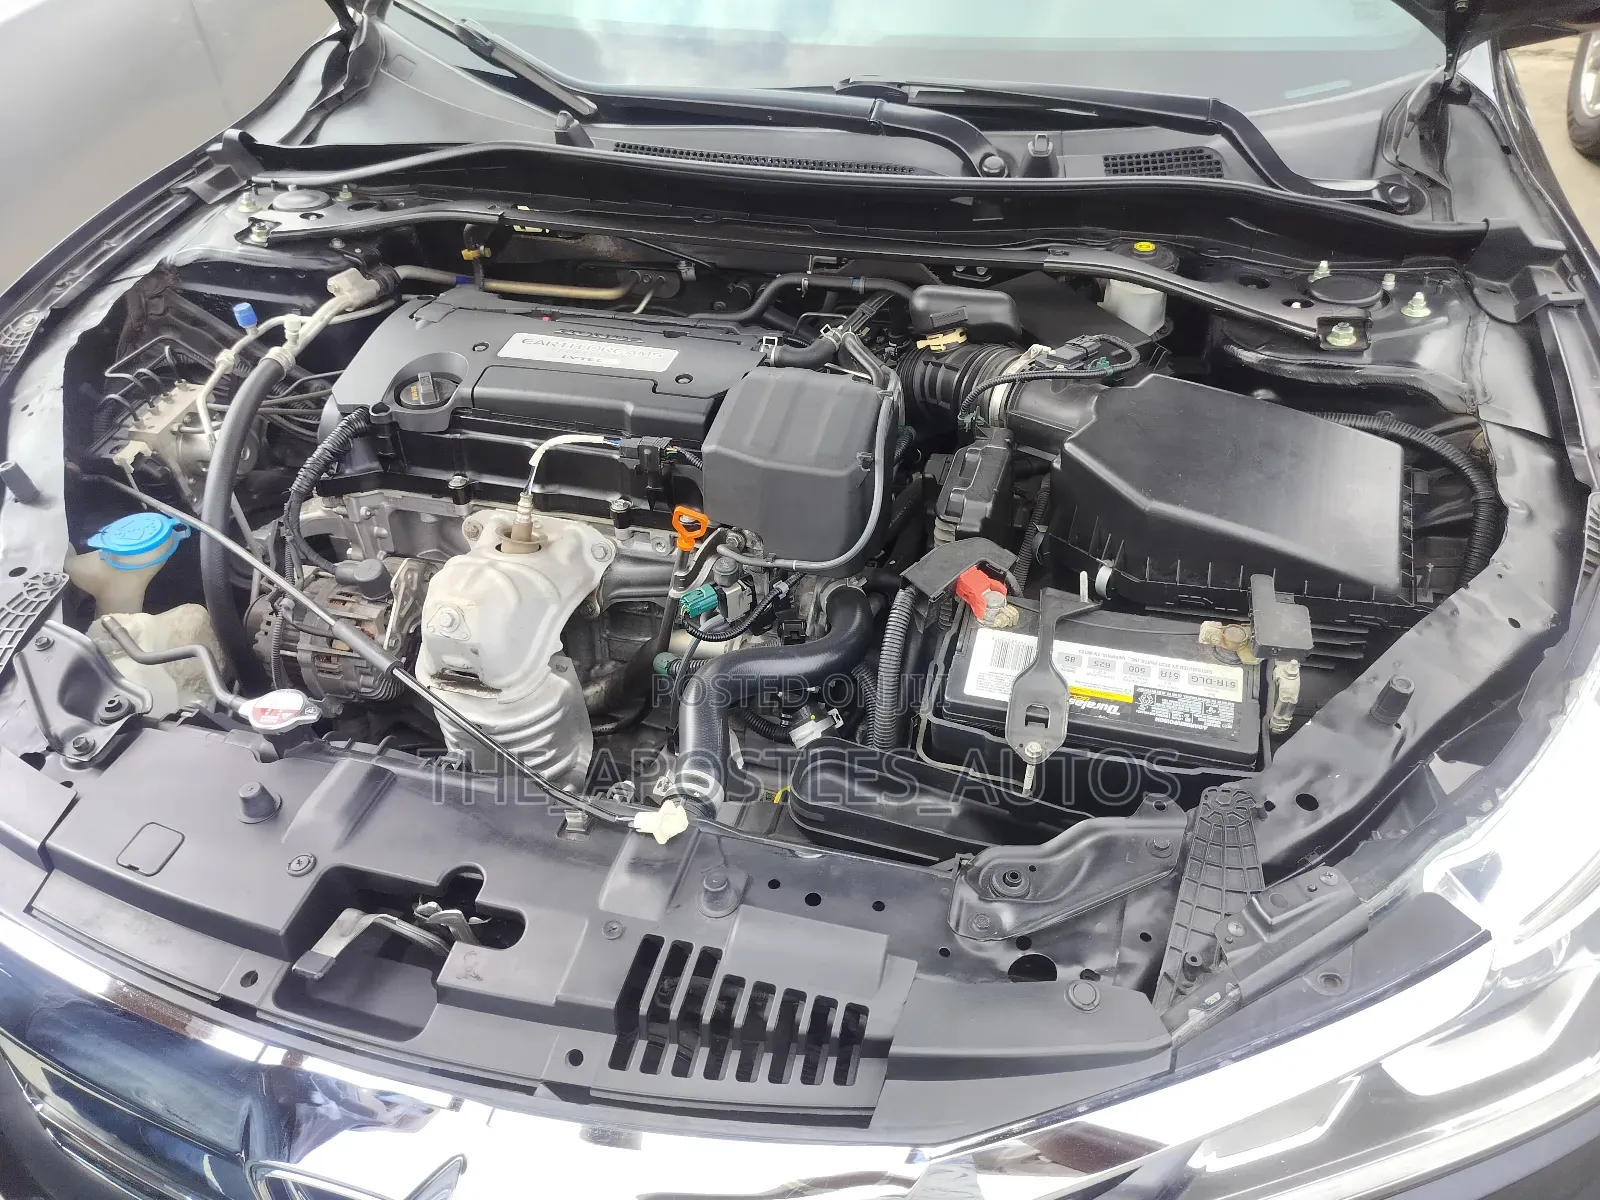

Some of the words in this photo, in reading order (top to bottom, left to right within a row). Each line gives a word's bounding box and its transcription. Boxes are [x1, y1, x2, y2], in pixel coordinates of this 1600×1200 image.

[554, 328, 645, 343] HONDA
[522, 338, 583, 350] EARTH
[586, 344, 663, 358] DREAMS
[1064, 655, 1076, 663] 85
[1093, 660, 1111, 669] 625
[1128, 665, 1146, 674] 500
[1160, 670, 1179, 680] 51R
[1179, 665, 1213, 675] DISTRIBUTED
[1191, 675, 1236, 689] 51R-DLG
[1068, 697, 1121, 716] Duralas
